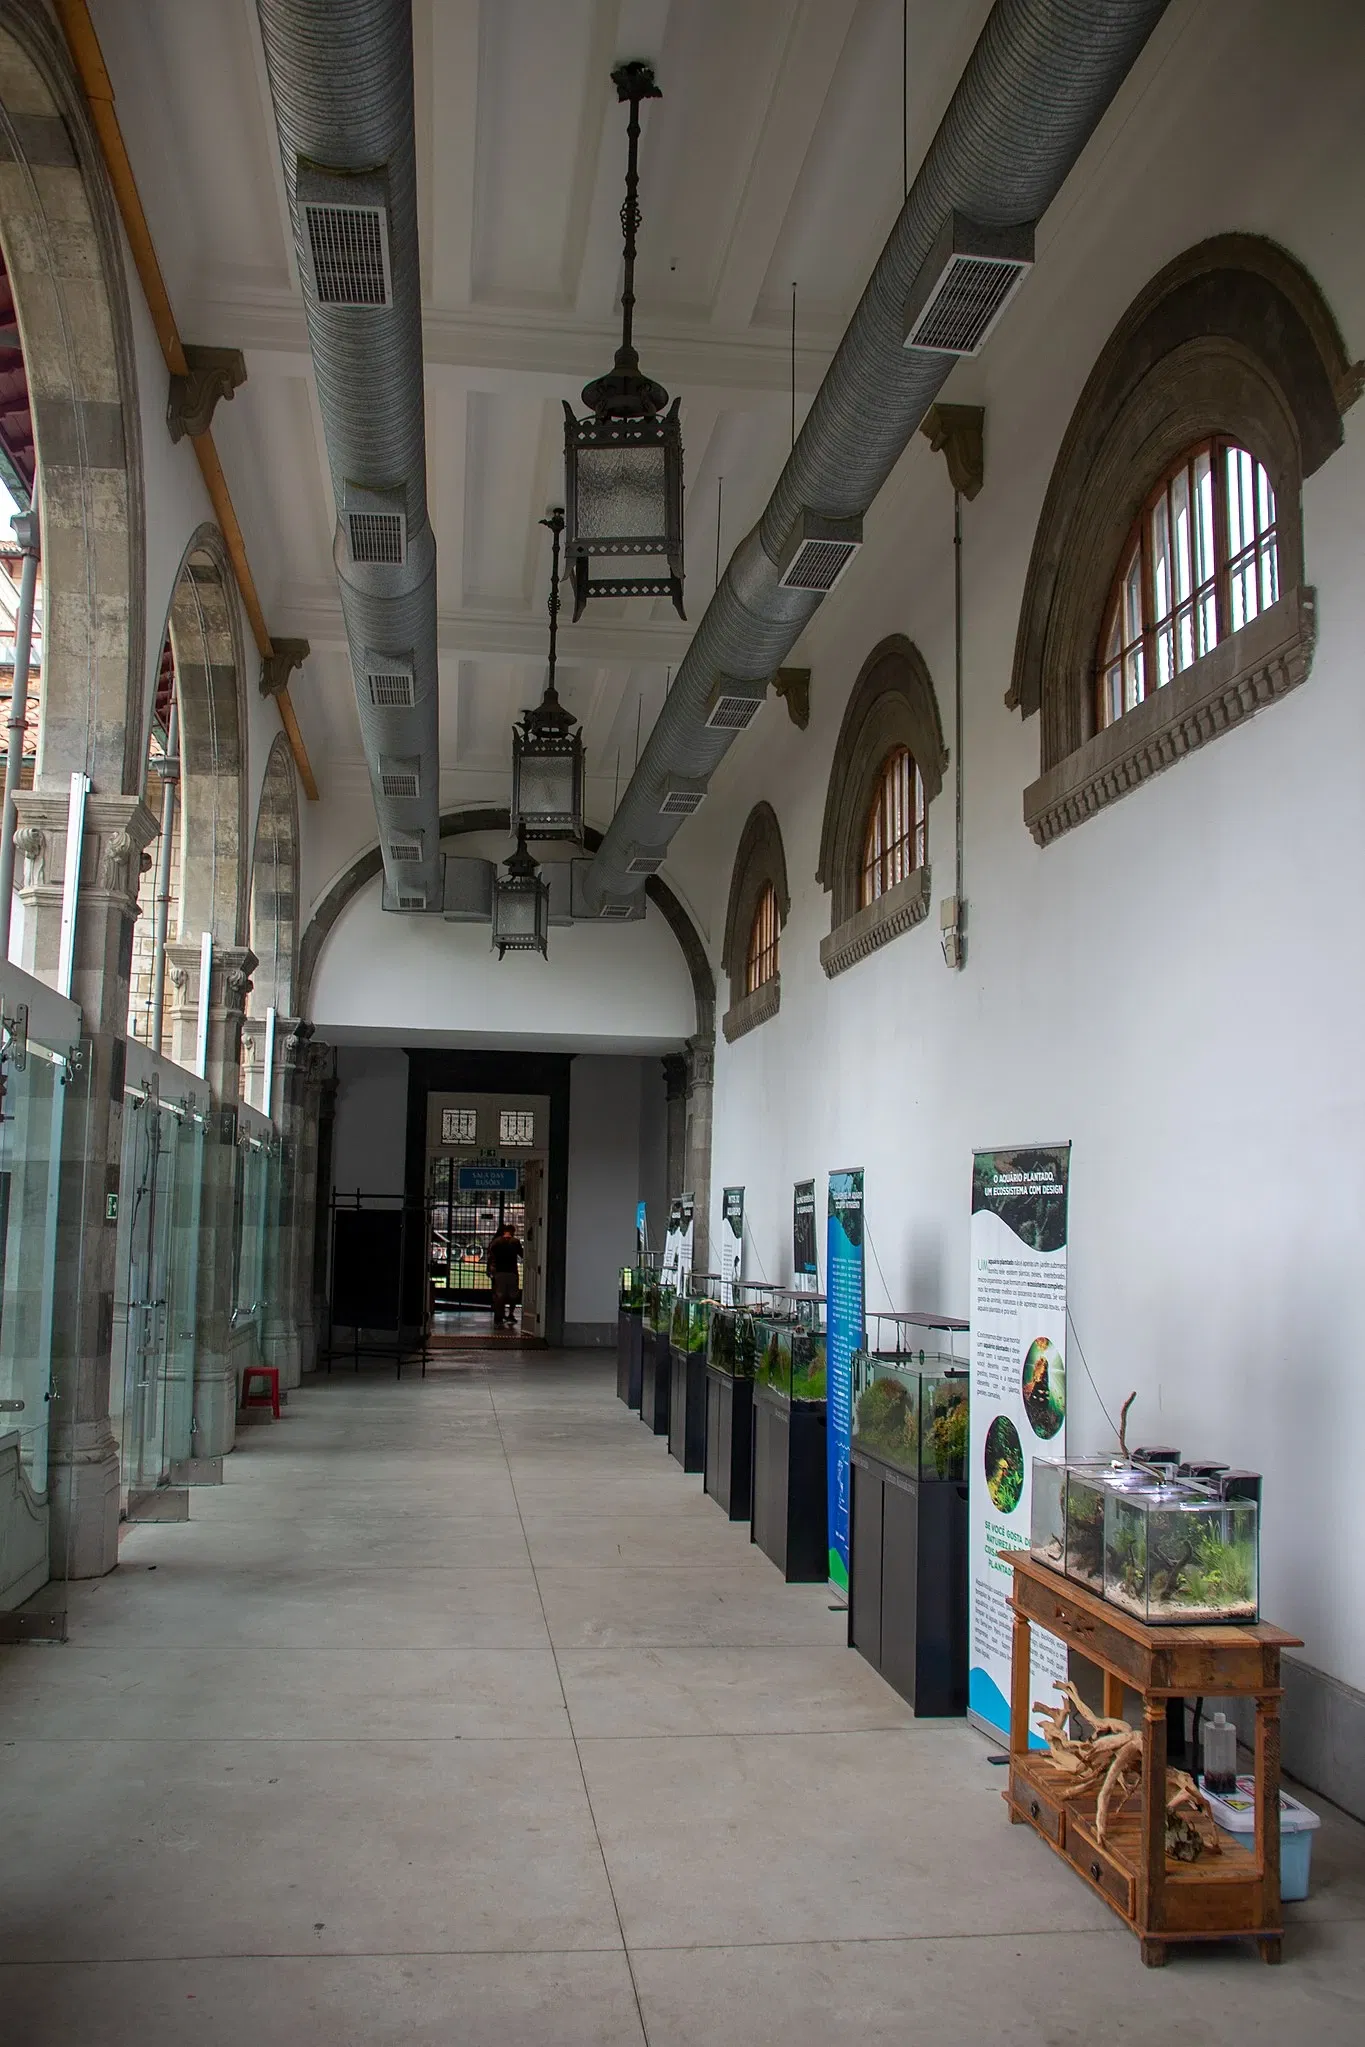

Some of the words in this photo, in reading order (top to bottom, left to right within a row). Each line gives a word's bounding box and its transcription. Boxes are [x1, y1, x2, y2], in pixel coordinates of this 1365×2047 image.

[993, 1174, 999, 1183] O
[999, 1171, 1023, 1183] AQUÁRIO
[1023, 1171, 1055, 1182] PLANTADO,
[984, 1187, 993, 1196] UM
[993, 1185, 1028, 1196] ECOSSISTEMA
[1029, 1185, 1041, 1195] COM
[1042, 1184, 1064, 1195] DESIGN
[984, 1520, 991, 1530] SE
[991, 1524, 1005, 1536] VOCÊ
[1006, 1530, 1023, 1544] GOSTA
